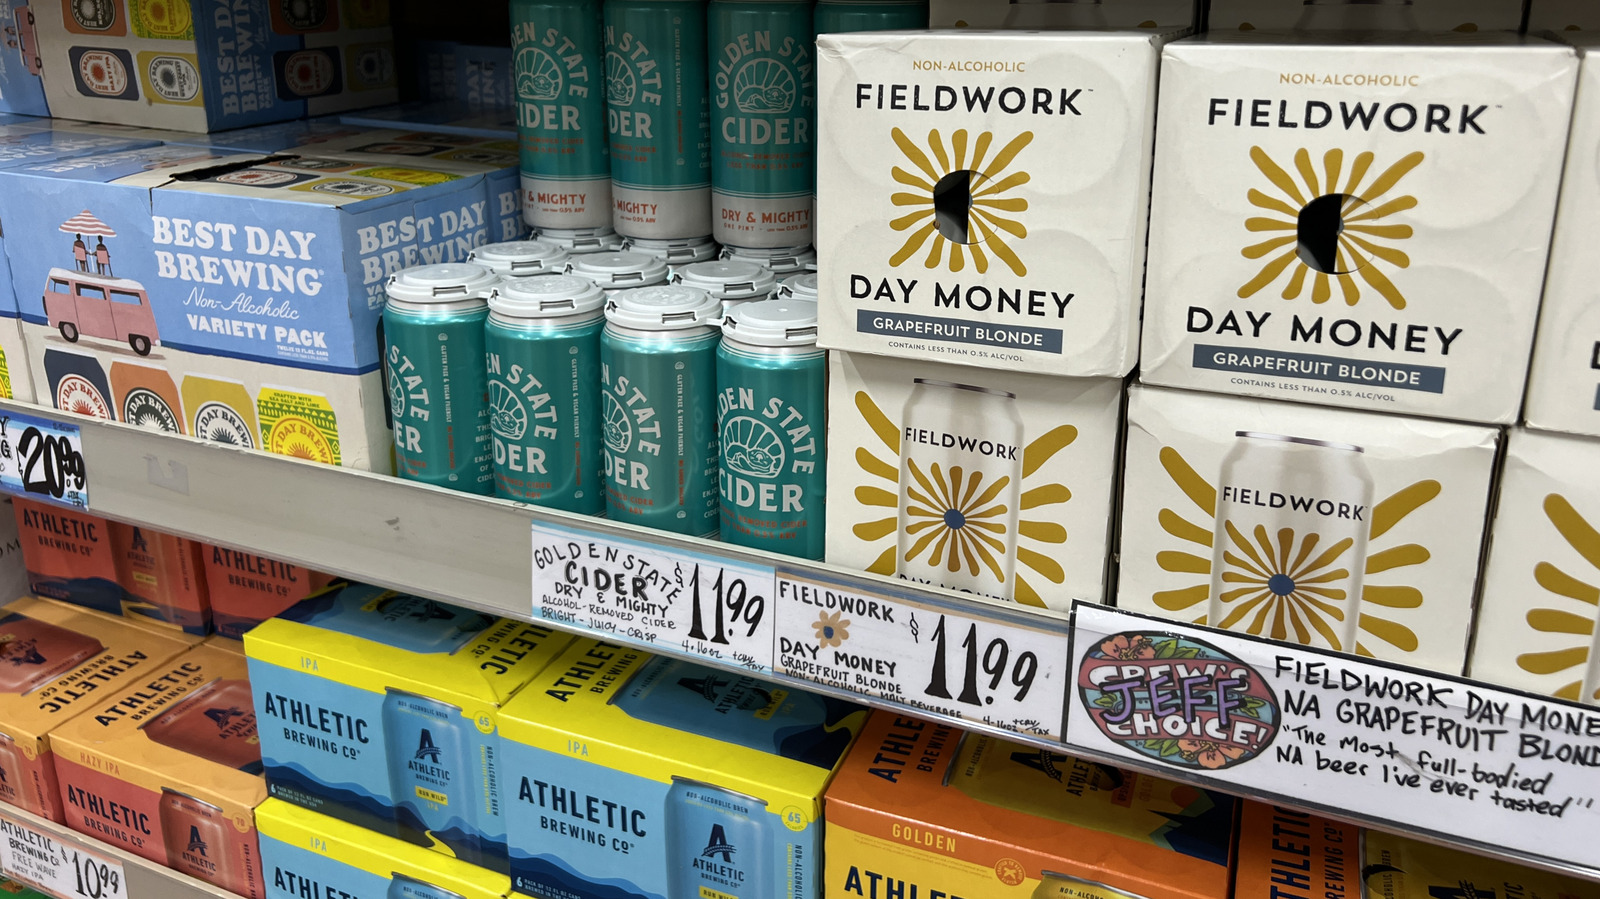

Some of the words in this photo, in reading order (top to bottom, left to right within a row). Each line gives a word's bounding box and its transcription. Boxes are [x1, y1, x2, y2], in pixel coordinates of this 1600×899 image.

[542, 28, 589, 98] STATE
[619, 33, 662, 107] STATE
[715, 30, 772, 109] GOLDEN
[912, 60, 1026, 73] NON-ALCOHOLIC
[1279, 73, 1420, 88] NON-ALCOHOLIC
[516, 101, 581, 131] IDER
[856, 83, 1082, 116] FIELDWORK
[721, 116, 808, 145] CIDER
[1207, 98, 1489, 135] FIELDWORK
[537, 192, 587, 205] MIGHTY
[617, 200, 658, 215] MIGHTY
[356, 215, 436, 256] BEST
[439, 200, 487, 238] DAY
[722, 208, 742, 222] DRY
[746, 211, 757, 223] &
[761, 208, 810, 224] MIGHTY
[152, 215, 237, 252] BEST
[244, 225, 317, 261] DAY
[154, 250, 323, 297] BREWING
[182, 286, 301, 321] Non-Alcoholic
[850, 274, 918, 304] DAY
[934, 281, 1075, 319] MONEY
[186, 313, 267, 343] VARIETY
[274, 325, 328, 350] PACK
[873, 317, 971, 339] GRAPEFRUIT
[975, 327, 1043, 347] BLONDE
[1186, 306, 1272, 339] DAY
[1289, 315, 1463, 356] MONEY
[888, 341, 926, 351] CONTAINS
[947, 347, 968, 355] THAN
[970, 349, 989, 358] 0.5%
[990, 353, 1025, 363] ALC/VOL
[1213, 351, 1333, 376] GRAPEFRUIT
[1338, 365, 1422, 386] BLONDE
[63, 381, 78, 399] DAY
[273, 391, 297, 401] CRAFTED
[298, 395, 312, 403] WITH
[389, 344, 430, 423] STATE
[1230, 377, 1276, 389] CONTAINS
[1278, 383, 1300, 391] LESS
[1302, 385, 1328, 394] THAN
[1330, 388, 1353, 397] 0.5%
[1354, 391, 1397, 402] ALC/VOL
[129, 395, 147, 412] DAY
[204, 409, 220, 427] DAY
[294, 399, 306, 407] AND
[506, 364, 558, 440] STATE
[613, 375, 662, 457] STATE
[279, 423, 298, 442] DAY
[761, 396, 816, 475] STATE
[905, 427, 1018, 461] FIELDWORK
[718, 469, 805, 513] CIDER
[1222, 486, 1365, 522] FIELDWORK
[23, 508, 99, 543] ATHLETIC
[738, 514, 778, 529] REMOVED
[781, 519, 807, 529] CIDER
[38, 535, 78, 554] BREWING
[213, 545, 298, 583] ATHLETIC
[534, 542, 619, 570] GOLDEN
[622, 554, 685, 605] STATE
[228, 574, 273, 593] BREWING
[564, 560, 649, 602] CIDER
[555, 581, 584, 600] DRY
[615, 595, 669, 619] MIGHTY
[779, 580, 895, 624] FIELDWORK
[541, 606, 577, 624] BRIGHT
[626, 627, 658, 644] CRISP
[641, 616, 677, 630] CIDER
[58, 654, 116, 687] BREWING
[301, 656, 319, 672] IPA
[589, 653, 638, 694] BREWING
[779, 637, 821, 660] DAY
[833, 650, 898, 679] MONEY
[780, 654, 851, 683] GRAPEFRUIT
[855, 673, 903, 695] BLONDE
[38, 650, 149, 713] ATHLETIC
[93, 662, 202, 727] ATHLETIC
[714, 675, 755, 715] ATHLETIC
[1274, 655, 1454, 708] FIELDWORK
[1465, 690, 1509, 726] DAY
[130, 686, 188, 721] BREWING
[265, 691, 370, 745] ATHLETIC
[880, 690, 907, 708] MALT
[910, 699, 963, 720] BEVERAGE
[1100, 673, 1247, 730] JEFF
[478, 715, 490, 727] 65
[1105, 712, 1269, 750] CHOICE!
[1284, 689, 1321, 719] NA
[1335, 698, 1509, 752] GRAPEFRUIT
[283, 727, 339, 755] BREWING
[567, 739, 590, 757] IPA
[79, 750, 101, 766] HAZY
[105, 759, 121, 776] IPA
[408, 759, 451, 781] ATHLETIC
[1276, 744, 1304, 765] NA
[1315, 749, 1369, 776] beer
[1429, 776, 1480, 801] ever
[1416, 750, 1555, 795] full-bodied
[67, 783, 151, 836] ATHLETIC
[518, 775, 647, 838] ATHLETIC
[686, 791, 732, 809] NON-ALCOHOLIC
[733, 804, 749, 815] BREW
[787, 811, 801, 824] 65
[0, 818, 55, 853] ATHLETIC
[84, 815, 128, 843] BREWING
[310, 836, 328, 852] IPA
[540, 815, 607, 847] BREWING
[892, 822, 957, 853] GOLDEN
[8, 837, 49, 862] BREWING
[12, 851, 34, 868] FREE
[35, 860, 57, 879] WAVE
[182, 851, 217, 872] ATHLETIC
[516, 876, 523, 887] 6
[524, 878, 536, 887] PACK
[692, 857, 745, 882] ATHLETIC
[700, 872, 729, 886] BREWING
[703, 889, 716, 897] RUN
